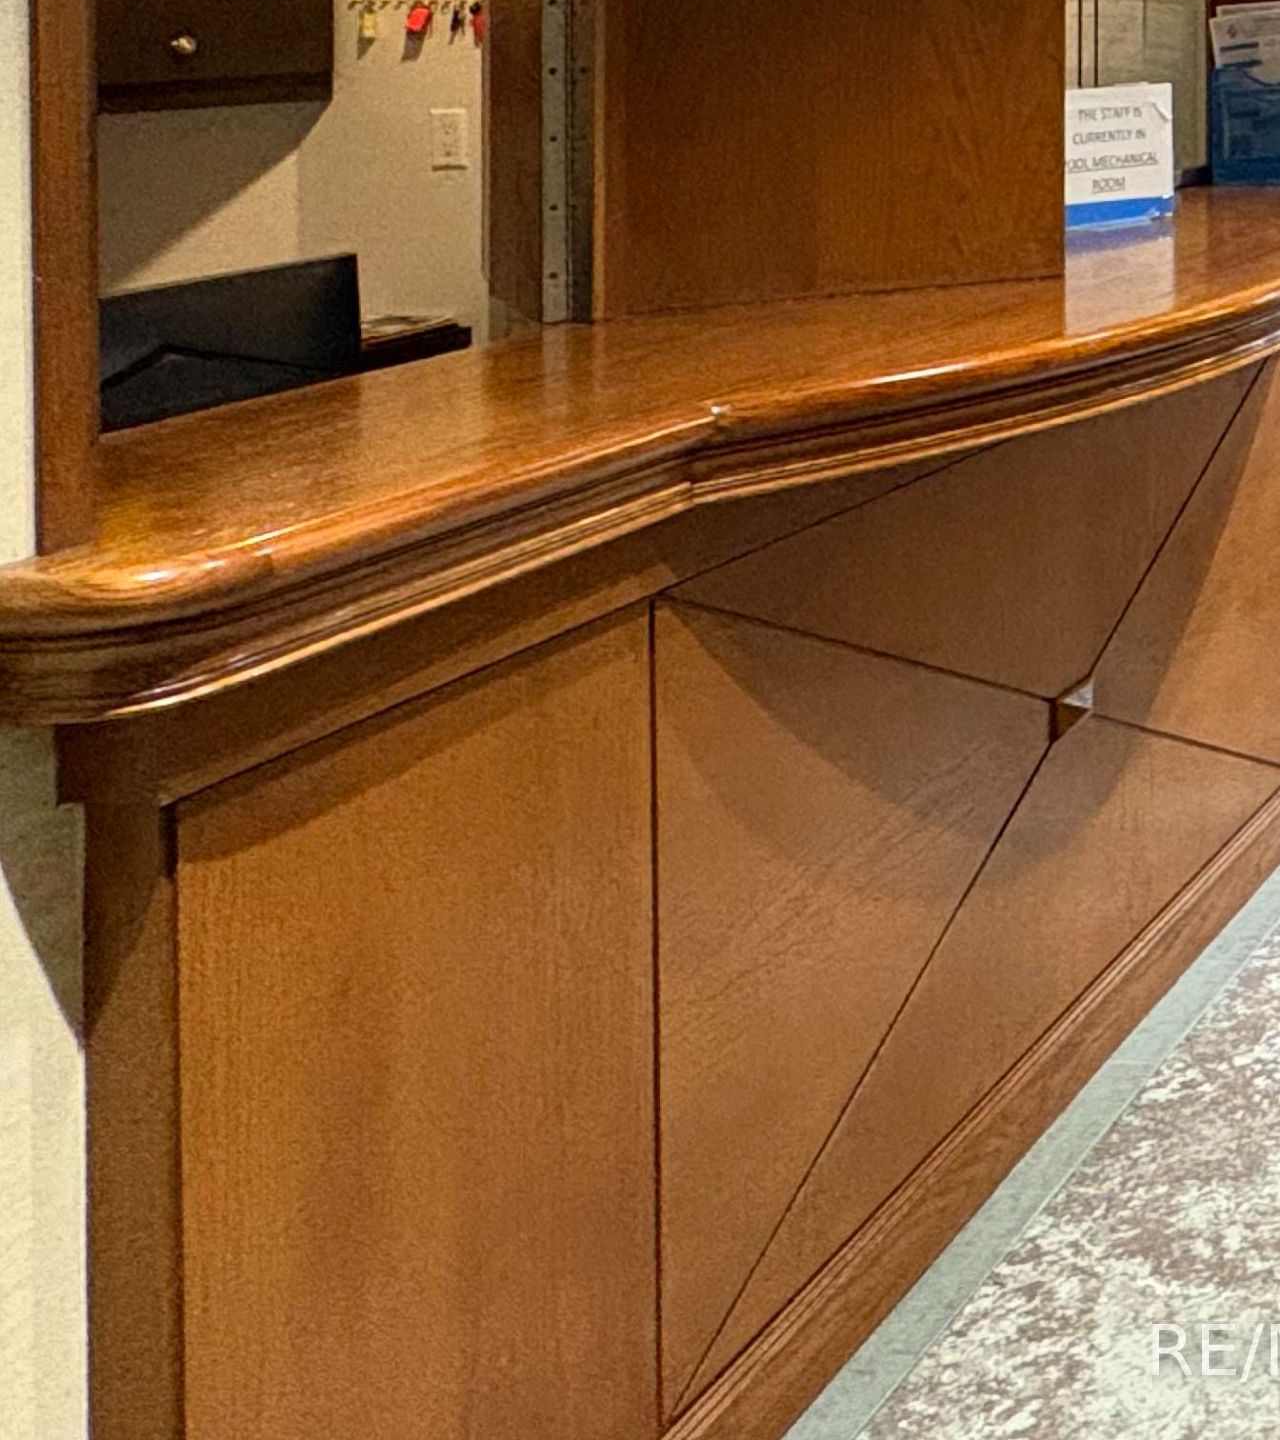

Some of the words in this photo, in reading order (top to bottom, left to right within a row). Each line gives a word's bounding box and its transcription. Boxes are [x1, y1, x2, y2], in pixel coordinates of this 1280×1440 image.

[1078, 109, 1097, 122] THE
[1101, 106, 1131, 120] STAFF
[1072, 128, 1132, 145] CURRENTLY
[1092, 177, 1126, 190] ROOM
